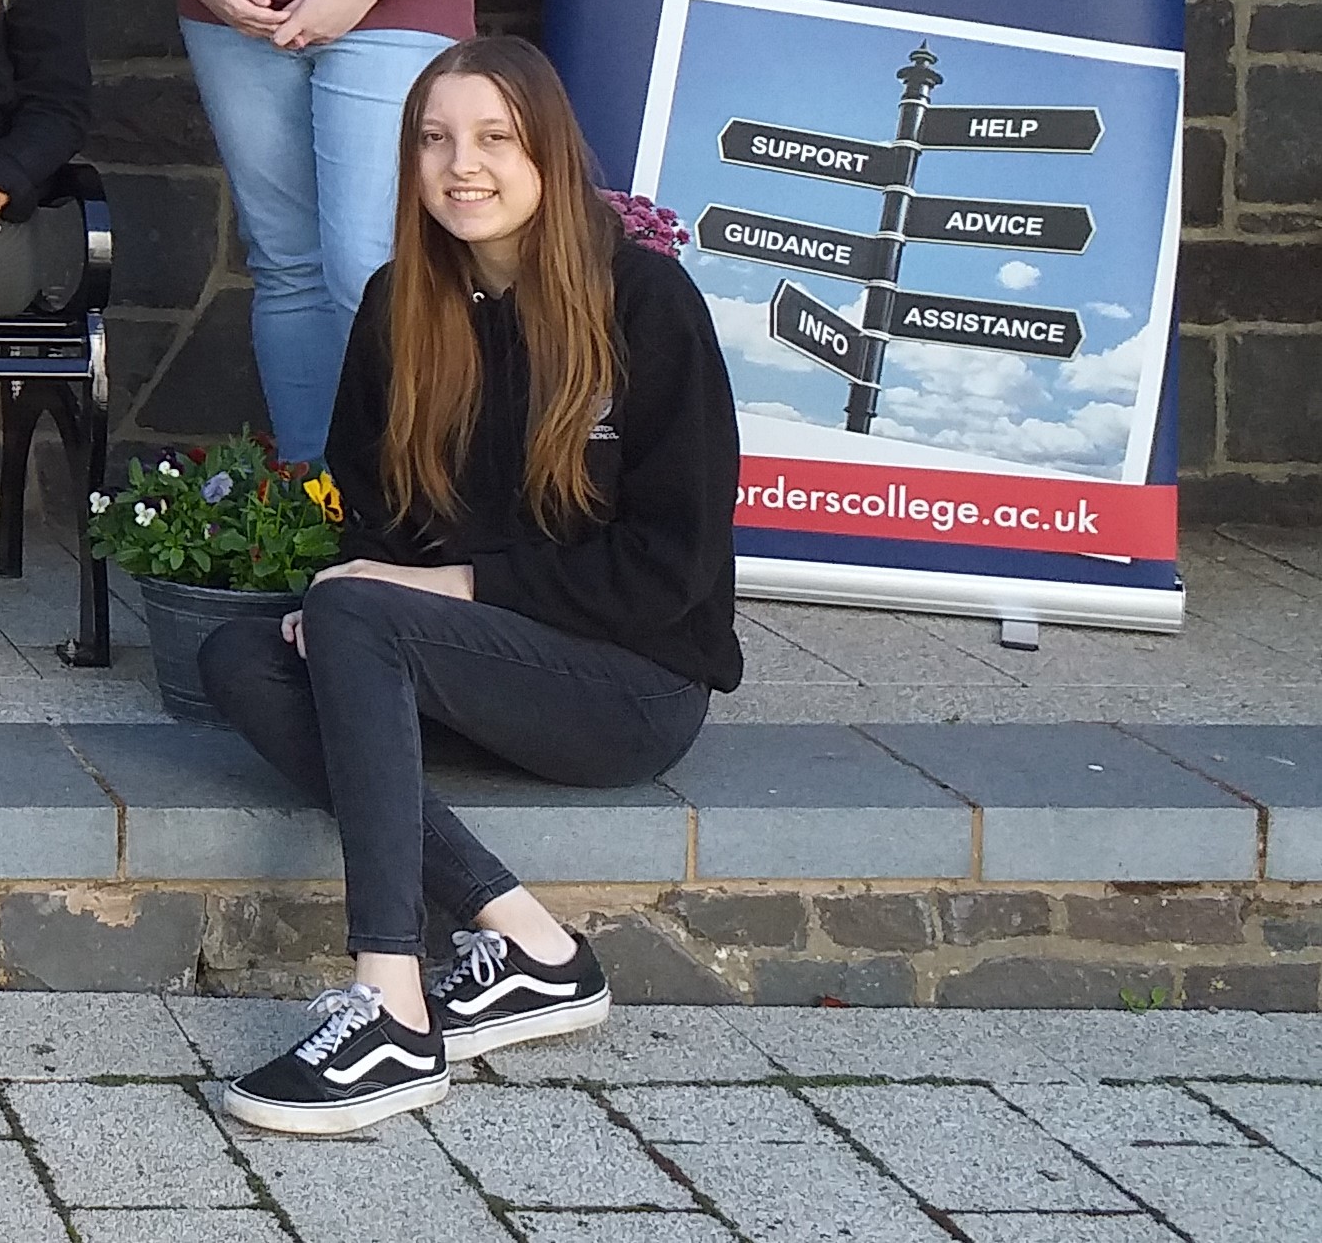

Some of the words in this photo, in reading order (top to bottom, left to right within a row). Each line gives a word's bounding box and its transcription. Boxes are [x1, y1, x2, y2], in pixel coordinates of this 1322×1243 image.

[970, 119, 1038, 137] HELP
[751, 136, 869, 173] SUPPORT
[945, 212, 1043, 235] ADVICE
[723, 223, 851, 264] GUIDANCE
[798, 310, 850, 357] INFO
[903, 307, 1065, 344] ASSISTANCE
